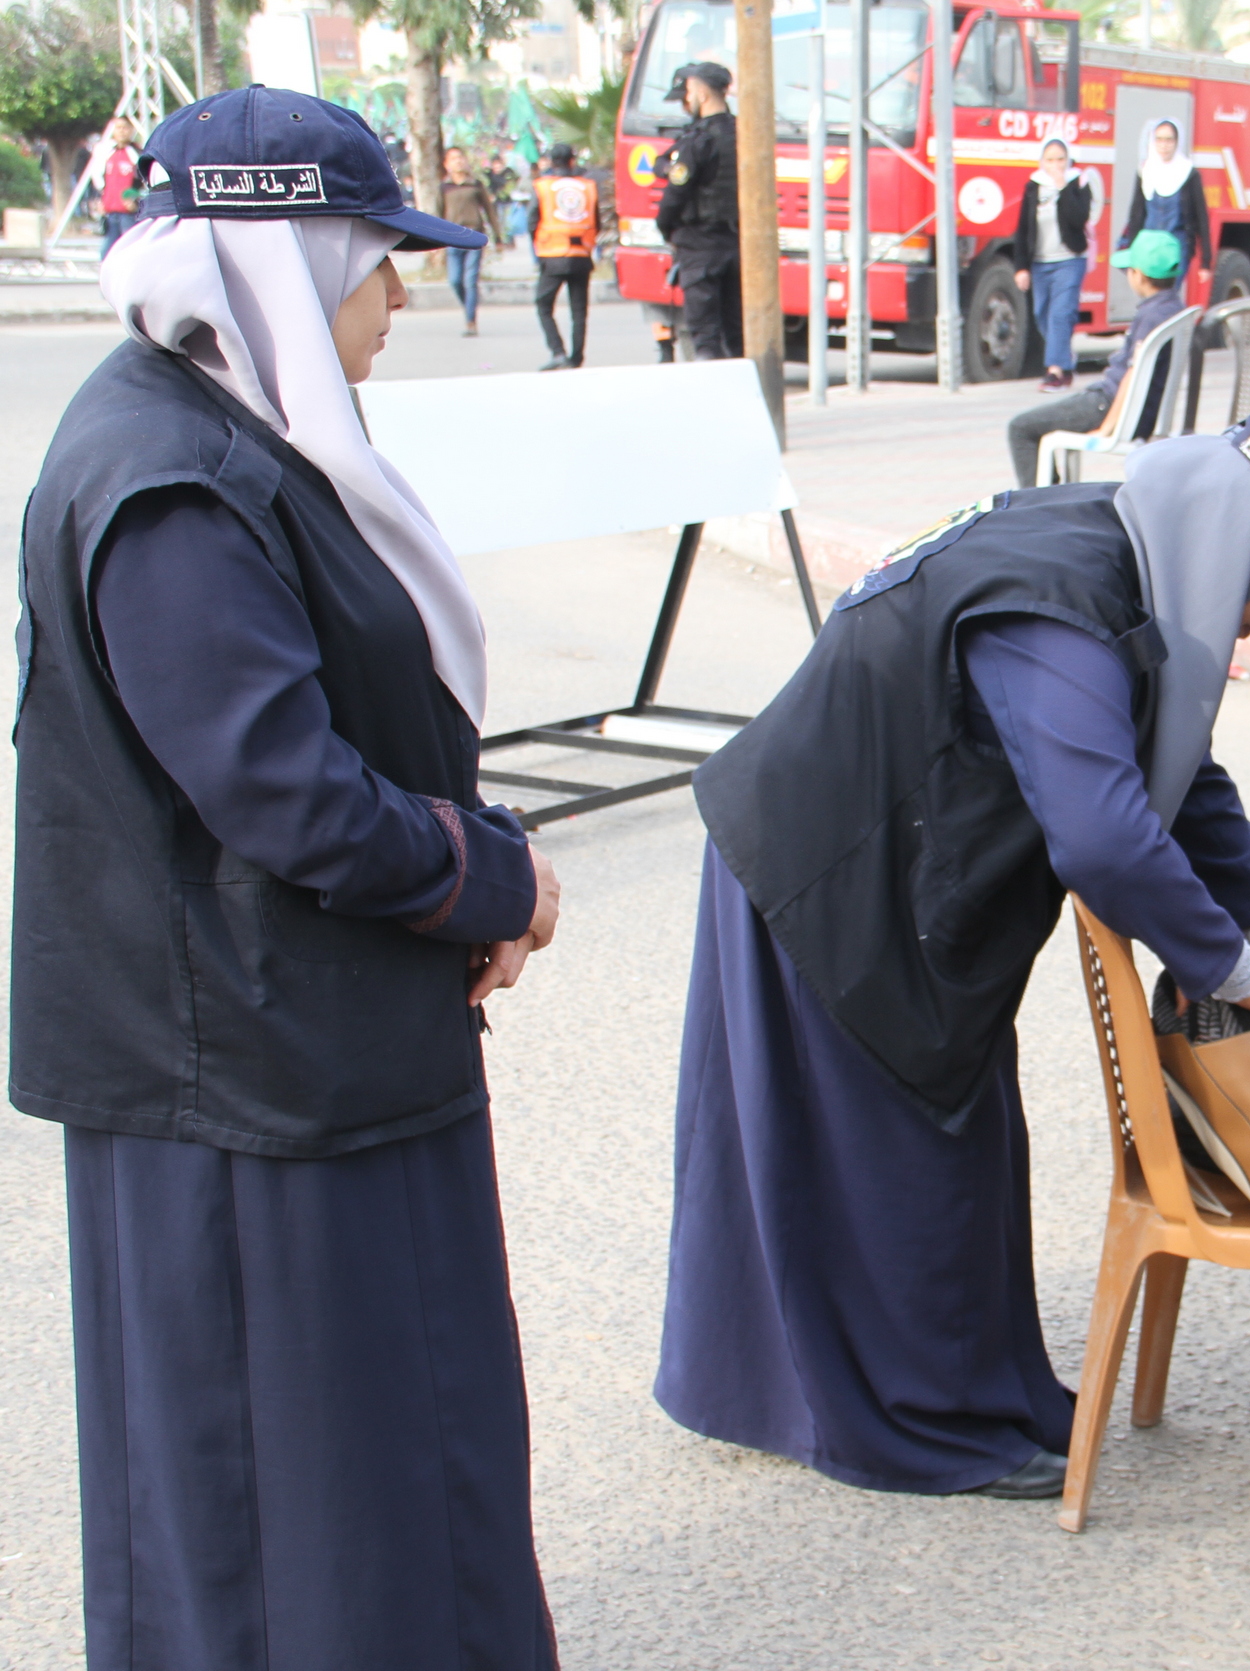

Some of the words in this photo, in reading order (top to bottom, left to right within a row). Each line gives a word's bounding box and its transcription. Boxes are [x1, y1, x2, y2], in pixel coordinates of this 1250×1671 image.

[999, 111, 1029, 137] CD
[1033, 113, 1078, 142] 1746
[198, 171, 255, 199] النسائية
[259, 170, 317, 200] الشرطة
